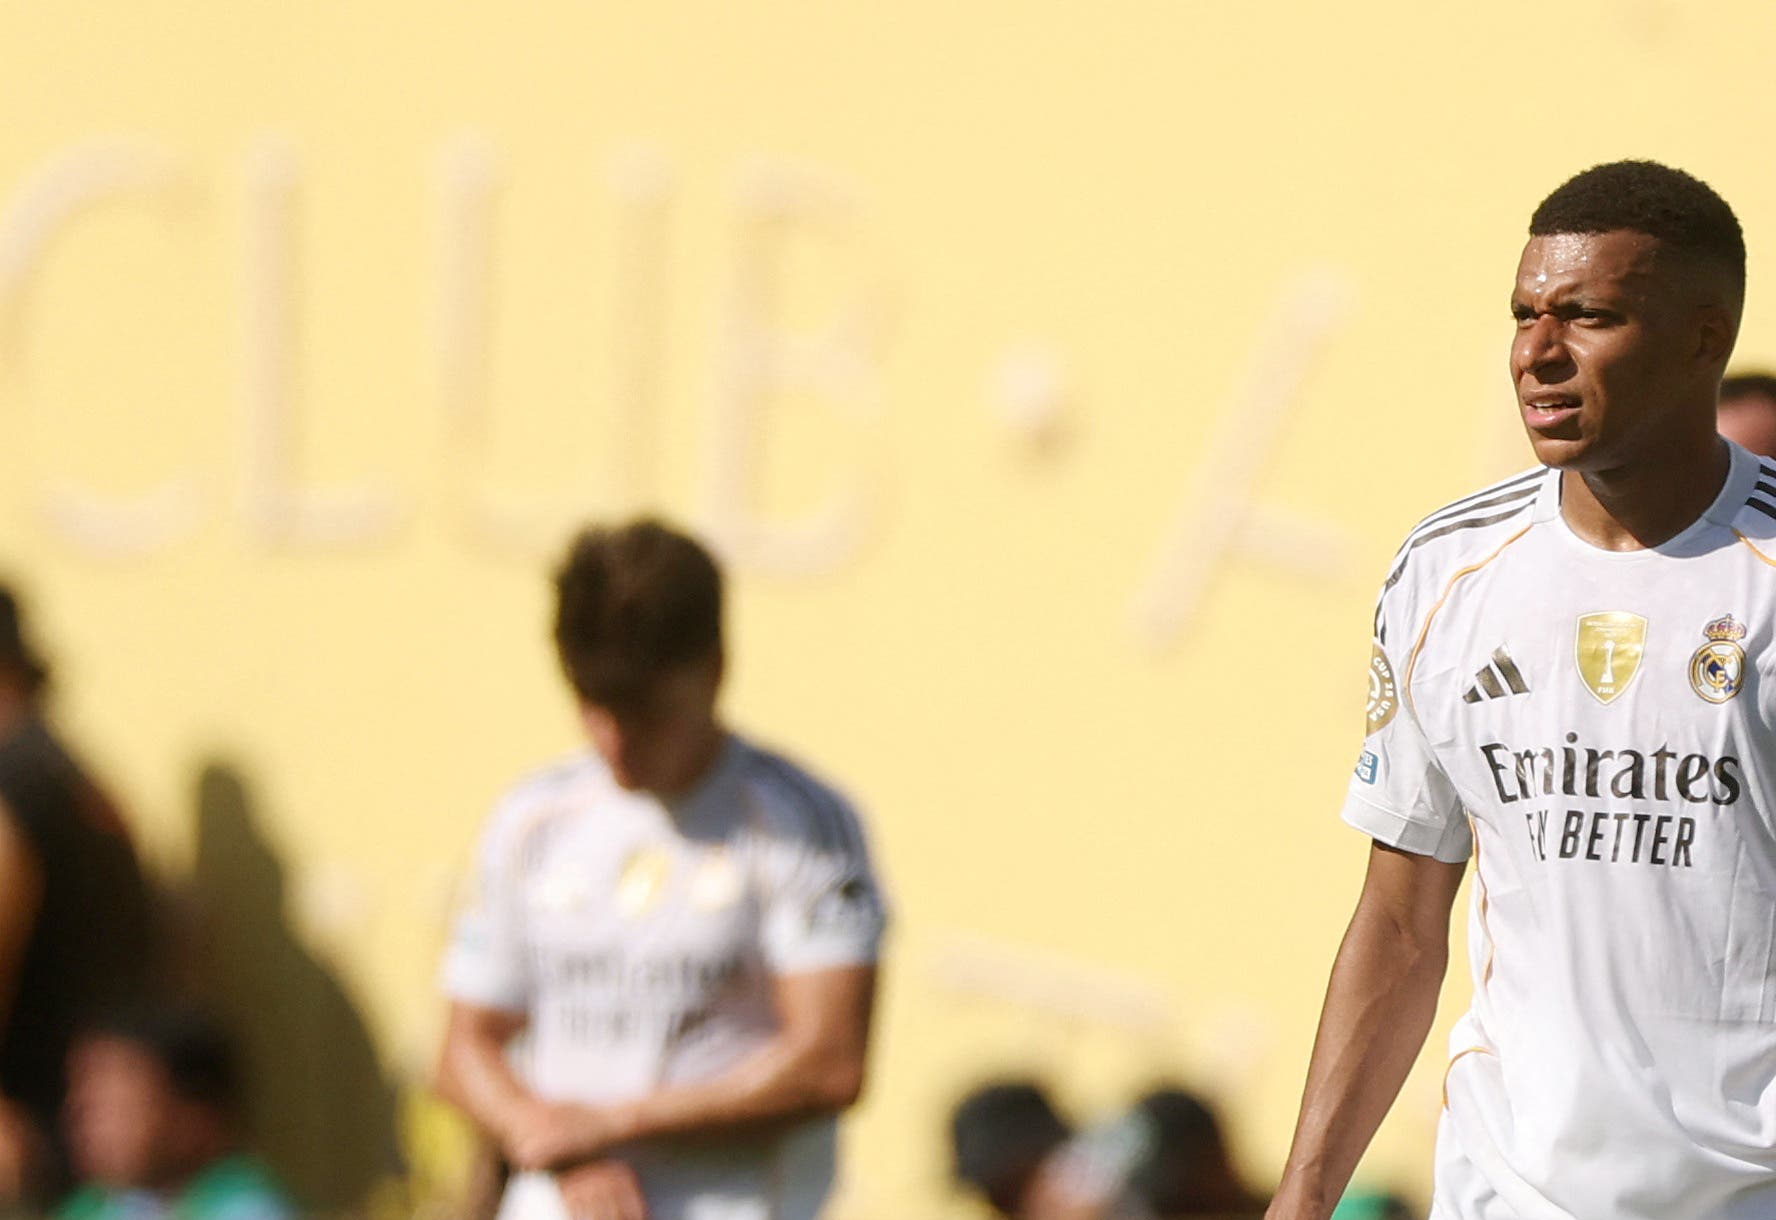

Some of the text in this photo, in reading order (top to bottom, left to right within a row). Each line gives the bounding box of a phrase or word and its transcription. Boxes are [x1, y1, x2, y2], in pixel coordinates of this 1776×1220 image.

[1373, 656, 1391, 679] CUP
[1480, 731, 1741, 806] Emirates
[1559, 810, 1696, 868] BETTER
